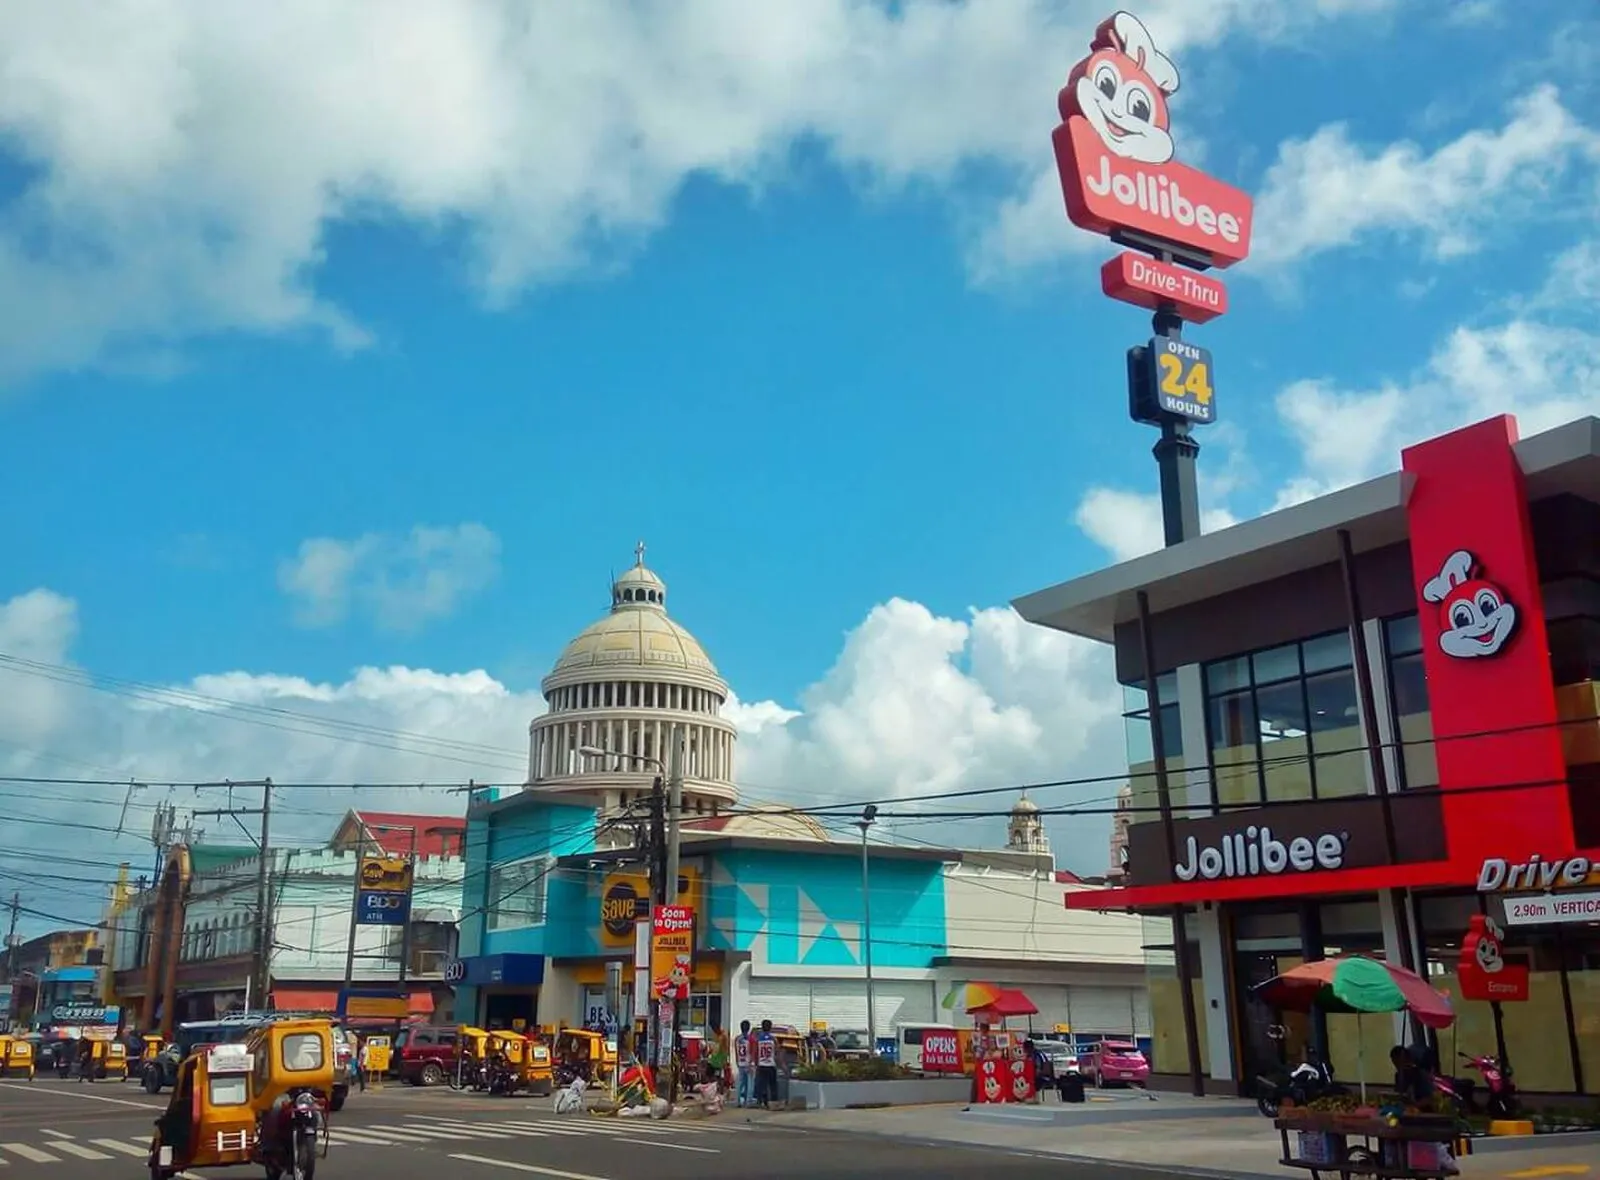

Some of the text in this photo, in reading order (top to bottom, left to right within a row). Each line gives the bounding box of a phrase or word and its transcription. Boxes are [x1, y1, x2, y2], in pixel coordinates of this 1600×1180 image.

[1086, 155, 1240, 243] Jollibee
[1132, 260, 1219, 306] Drive-Thru
[1168, 341, 1200, 360] OPEN
[1160, 353, 1212, 405] 24
[1166, 396, 1209, 418] HOURS
[1175, 825, 1343, 881] Jollibee
[661, 907, 686, 919] Soon
[664, 918, 692, 932] Open!
[926, 1036, 956, 1054] OPENS
